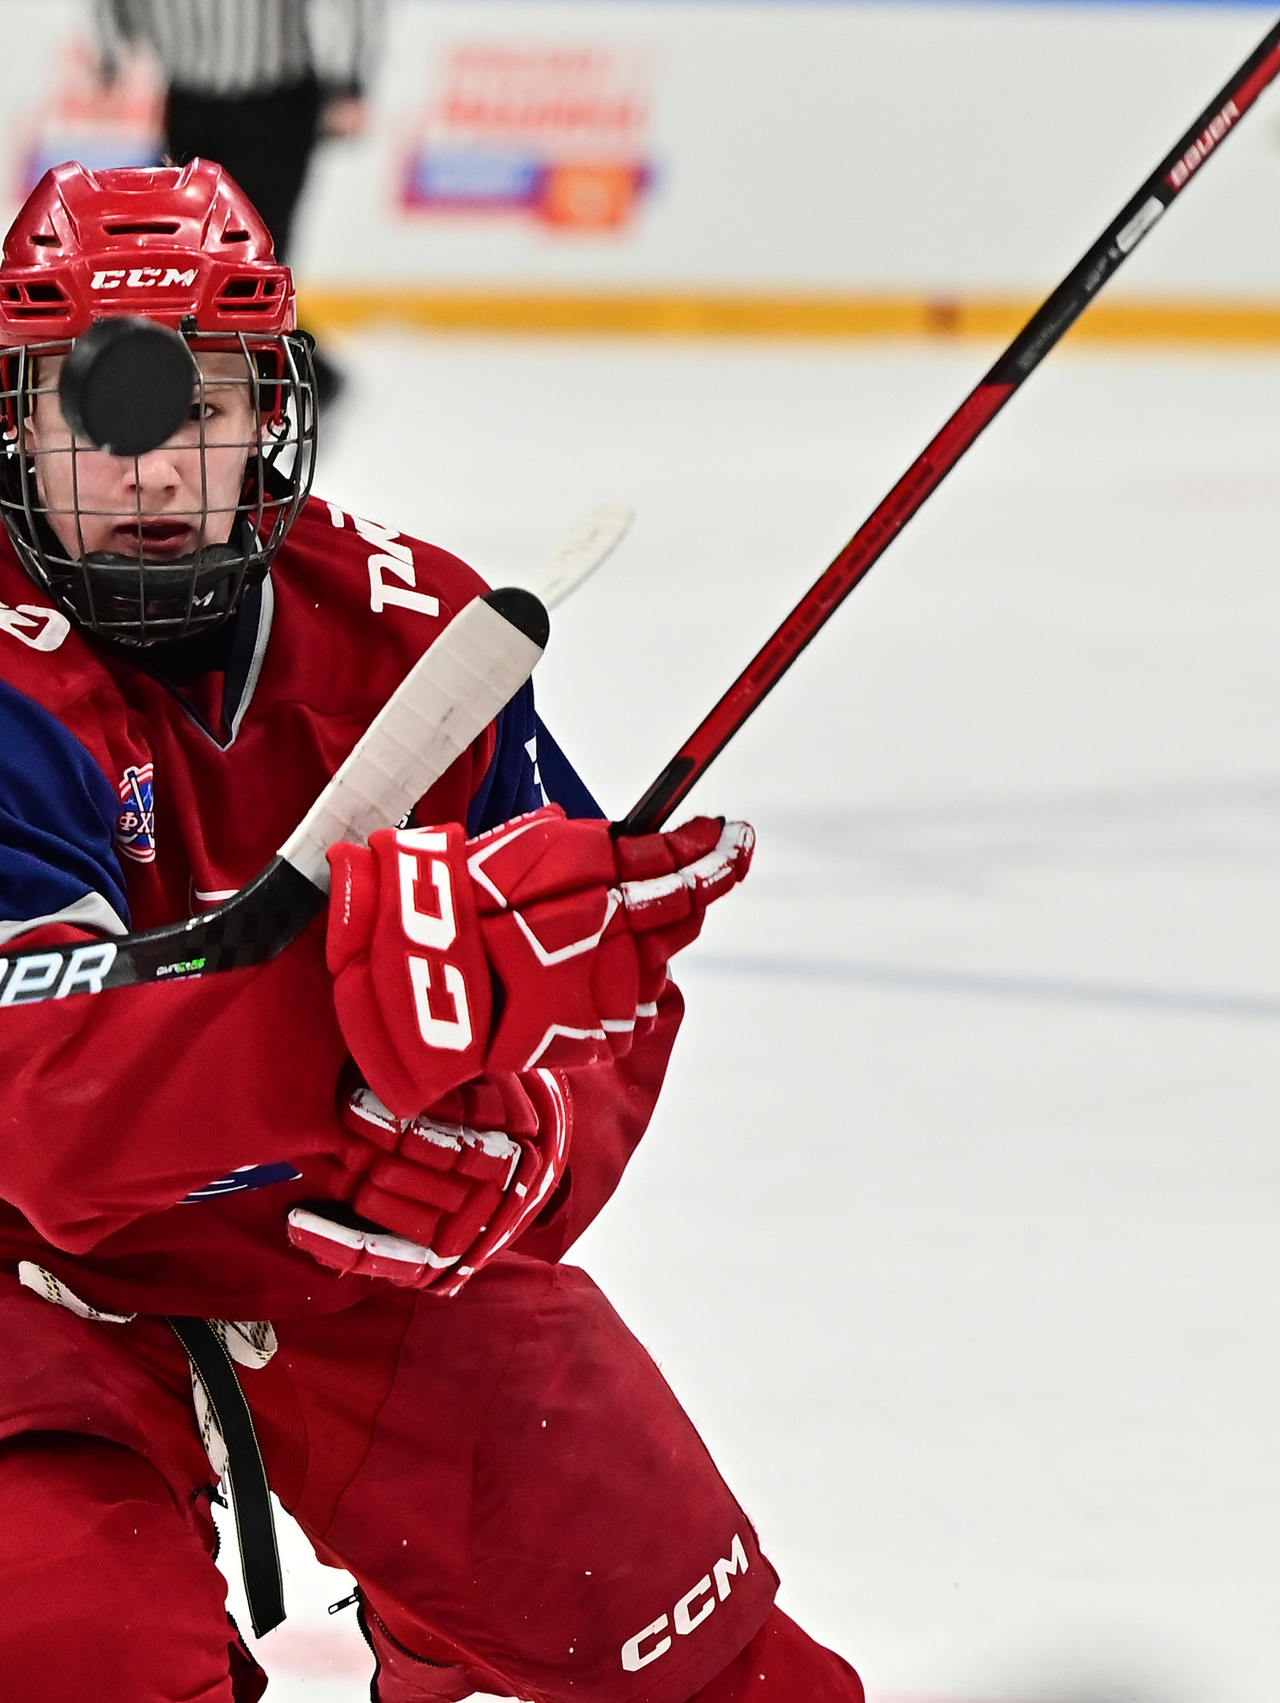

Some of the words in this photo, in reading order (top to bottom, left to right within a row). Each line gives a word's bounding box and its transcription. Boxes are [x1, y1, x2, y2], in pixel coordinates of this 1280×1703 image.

[91, 268, 198, 289] CCM
[119, 811, 155, 835] ФХ
[621, 1532, 749, 1671] CCM
